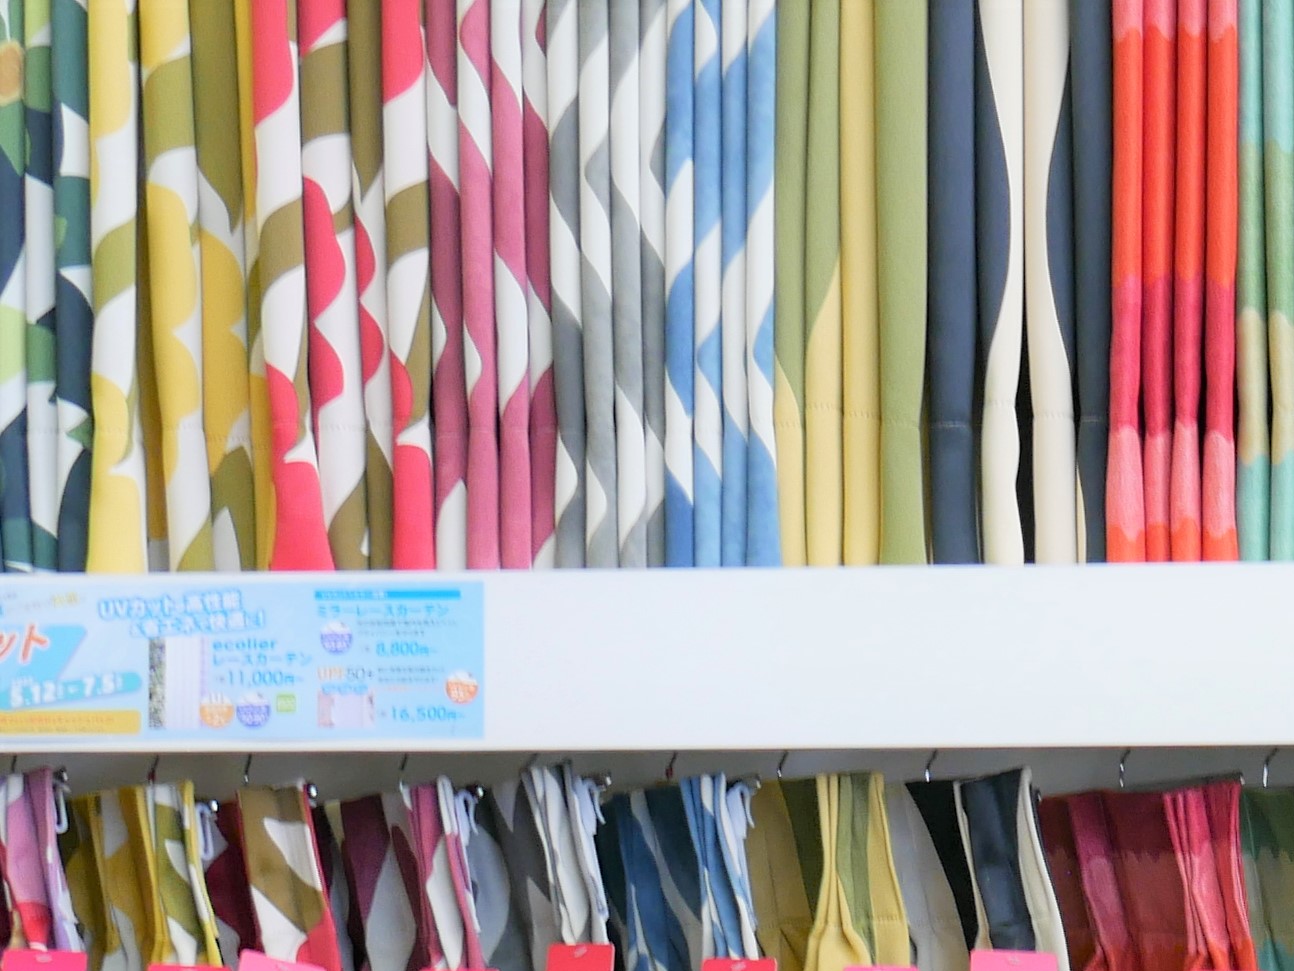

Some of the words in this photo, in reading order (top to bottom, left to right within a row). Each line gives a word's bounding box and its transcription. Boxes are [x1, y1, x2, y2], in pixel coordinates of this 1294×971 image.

[213, 653, 312, 666] レースカーテン
